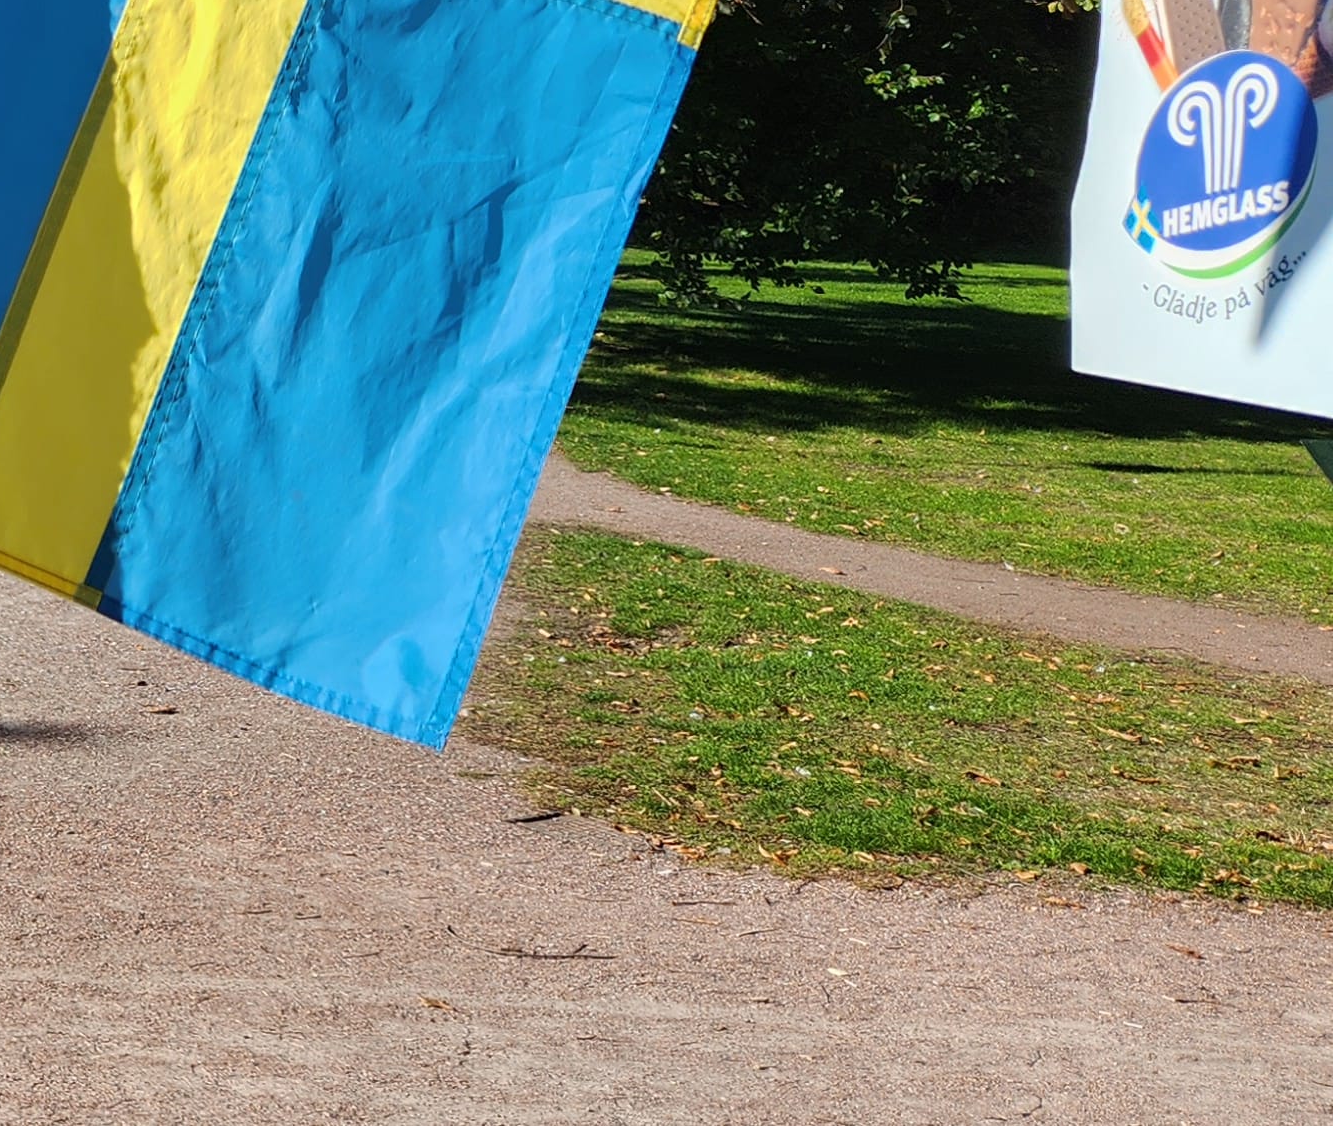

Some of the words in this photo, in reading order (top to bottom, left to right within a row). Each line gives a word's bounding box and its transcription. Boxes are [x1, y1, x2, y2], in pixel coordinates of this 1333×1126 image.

[1162, 180, 1290, 238] HEMGLASS
[1153, 283, 1218, 324] Glädje
[1224, 286, 1252, 320] på
